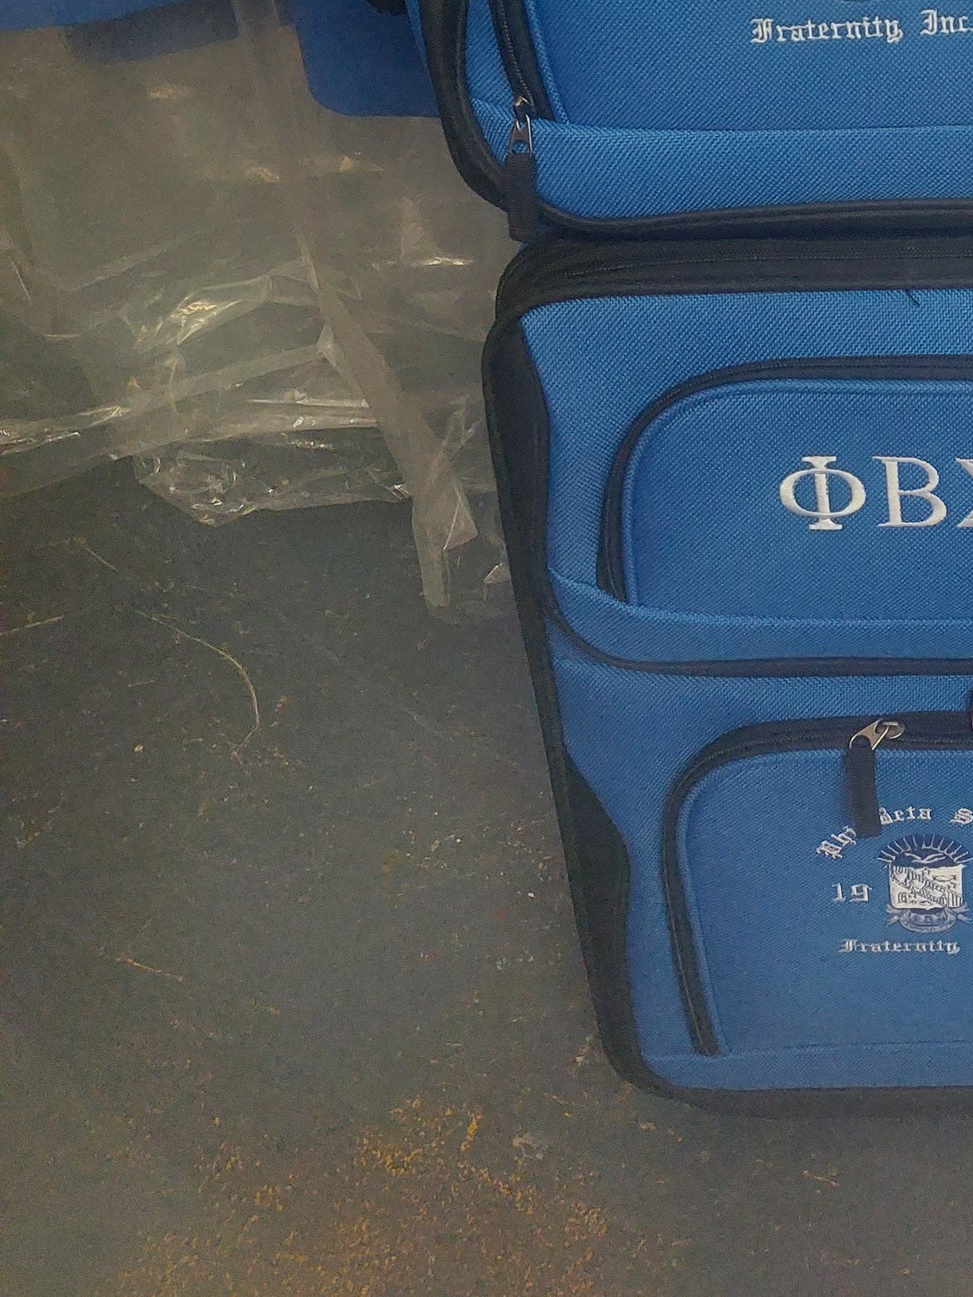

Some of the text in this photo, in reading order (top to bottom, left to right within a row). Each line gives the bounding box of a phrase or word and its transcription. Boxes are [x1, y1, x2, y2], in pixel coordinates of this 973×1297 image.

[750, 15, 904, 45] Fraternity
[831, 882, 873, 904] 19
[838, 938, 961, 955] Fraternity
